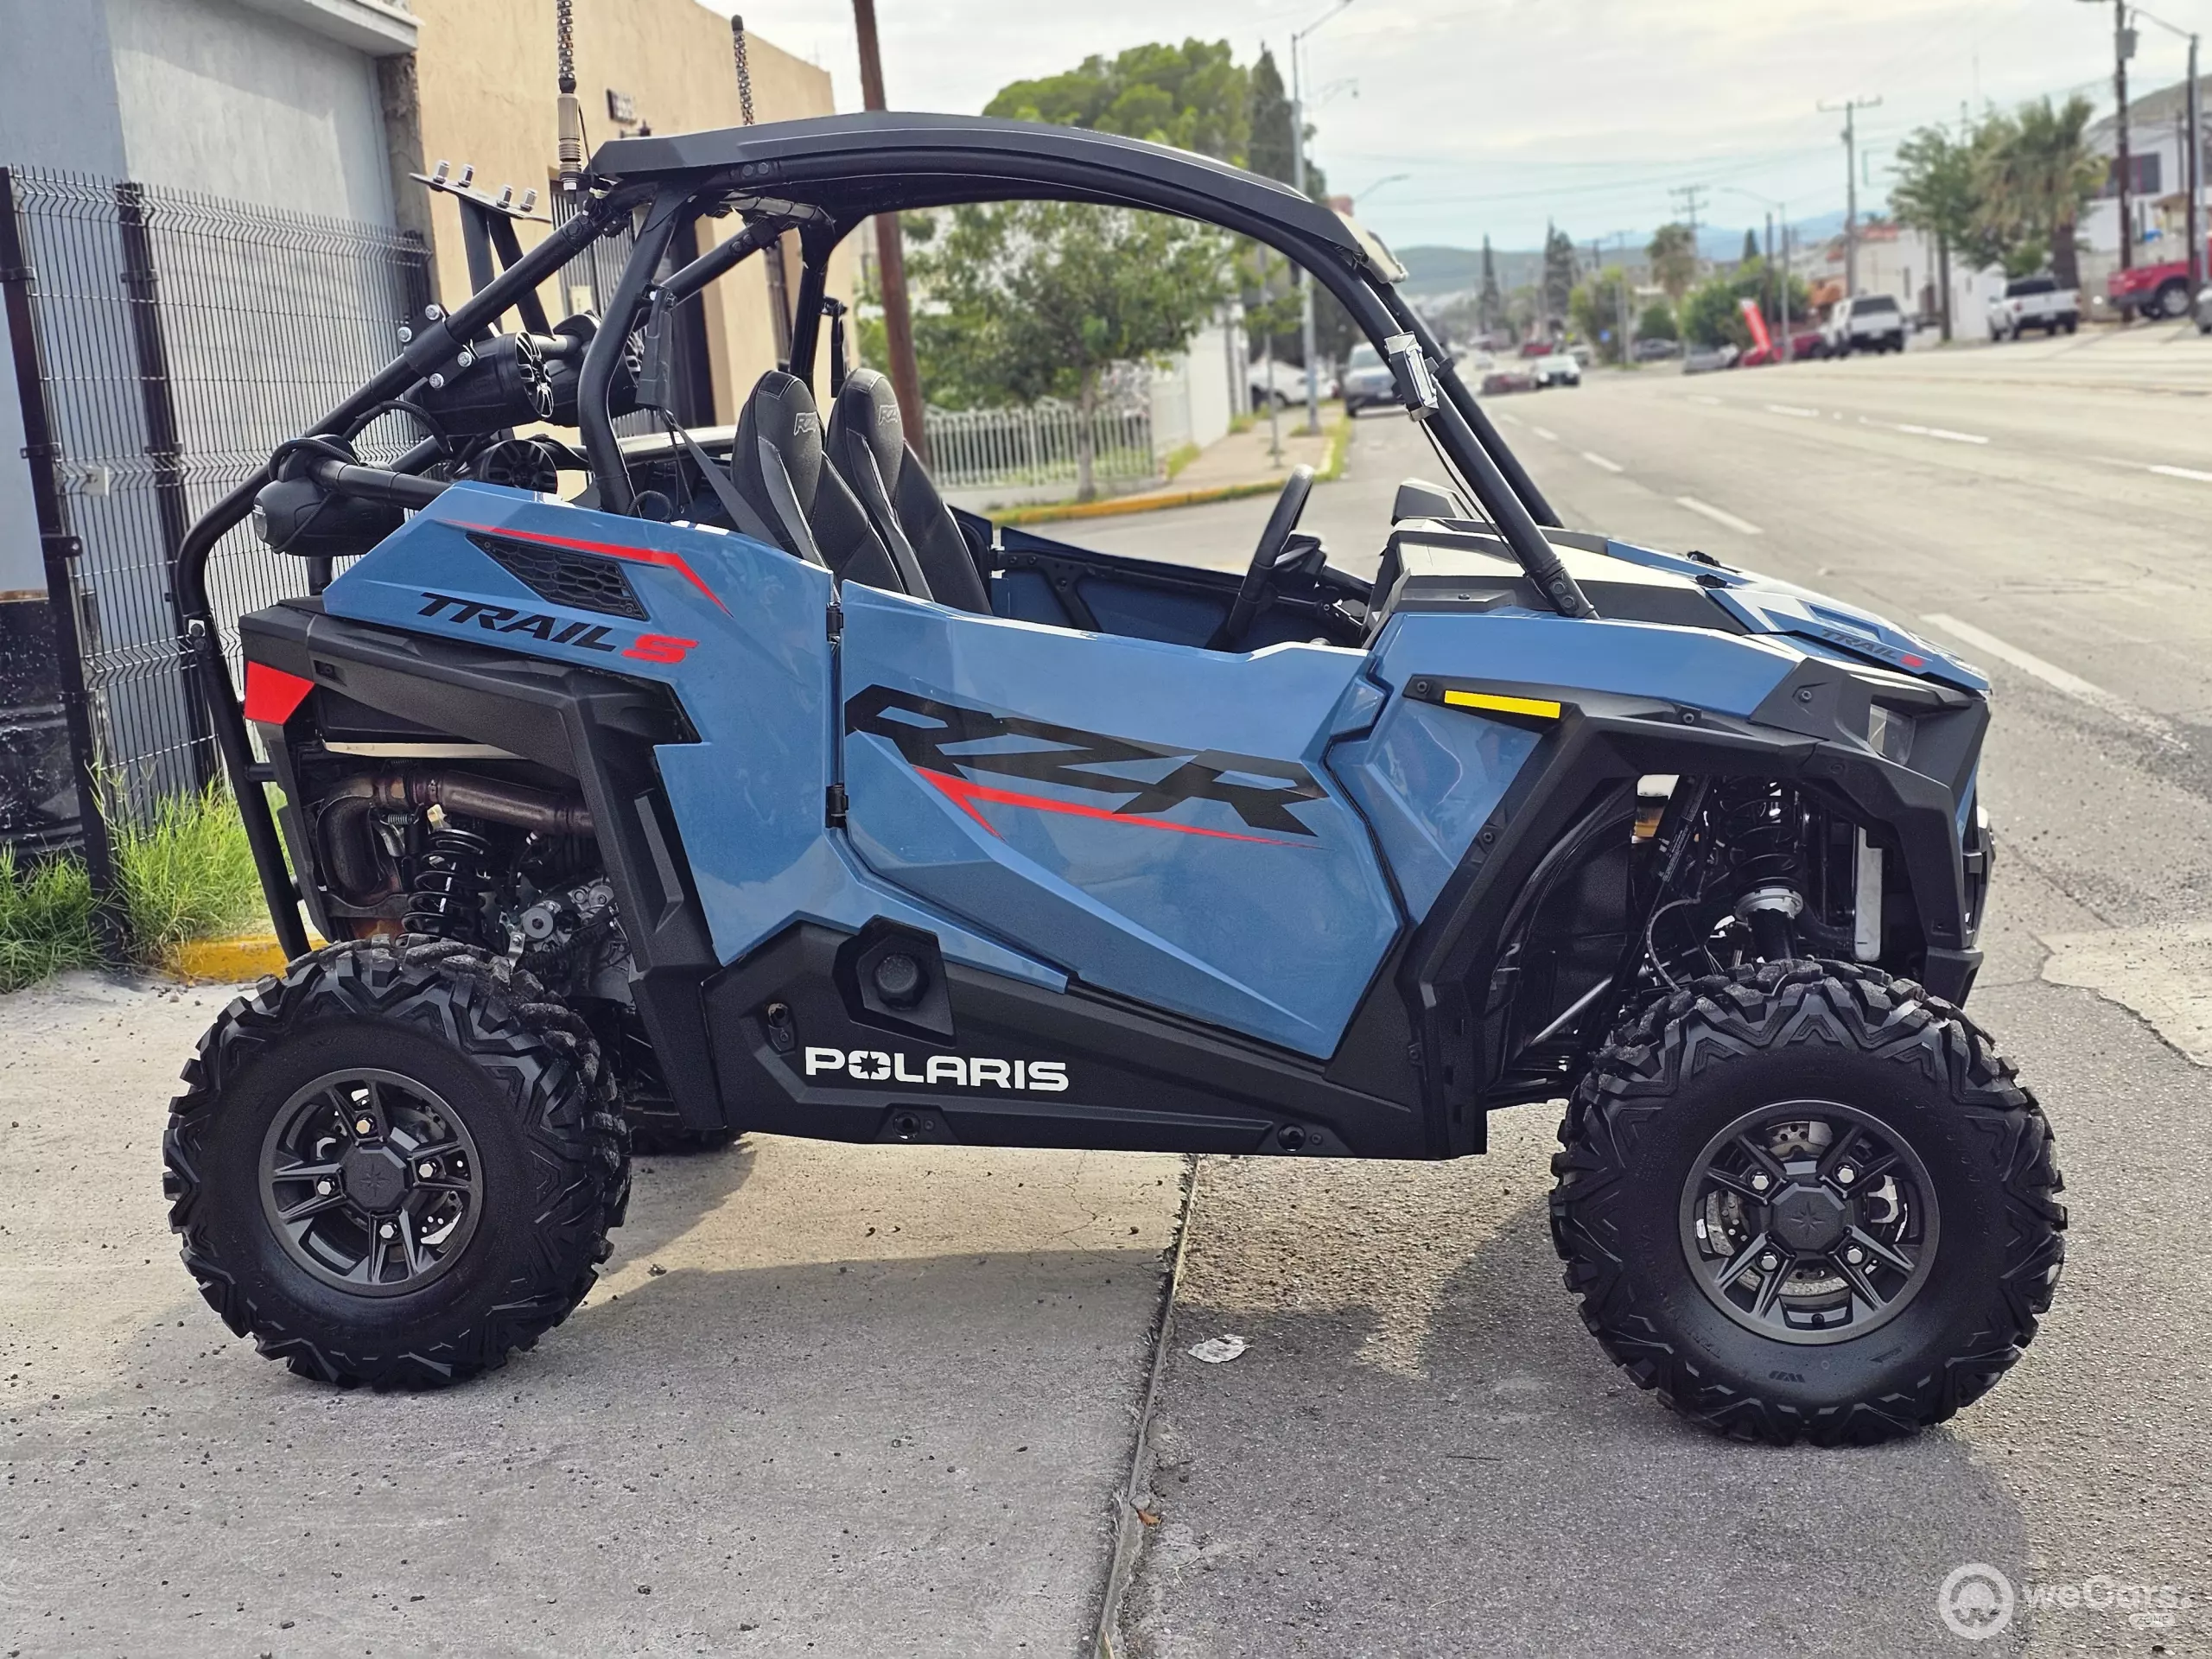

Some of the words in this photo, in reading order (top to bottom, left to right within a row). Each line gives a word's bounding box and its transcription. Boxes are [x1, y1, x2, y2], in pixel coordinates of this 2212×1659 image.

[416, 592, 617, 653] TRAIL
[620, 633, 700, 664] S
[1821, 628, 1897, 659] TRAIL
[844, 683, 1331, 837] RZR
[804, 1046, 1070, 1092] POLARIS
